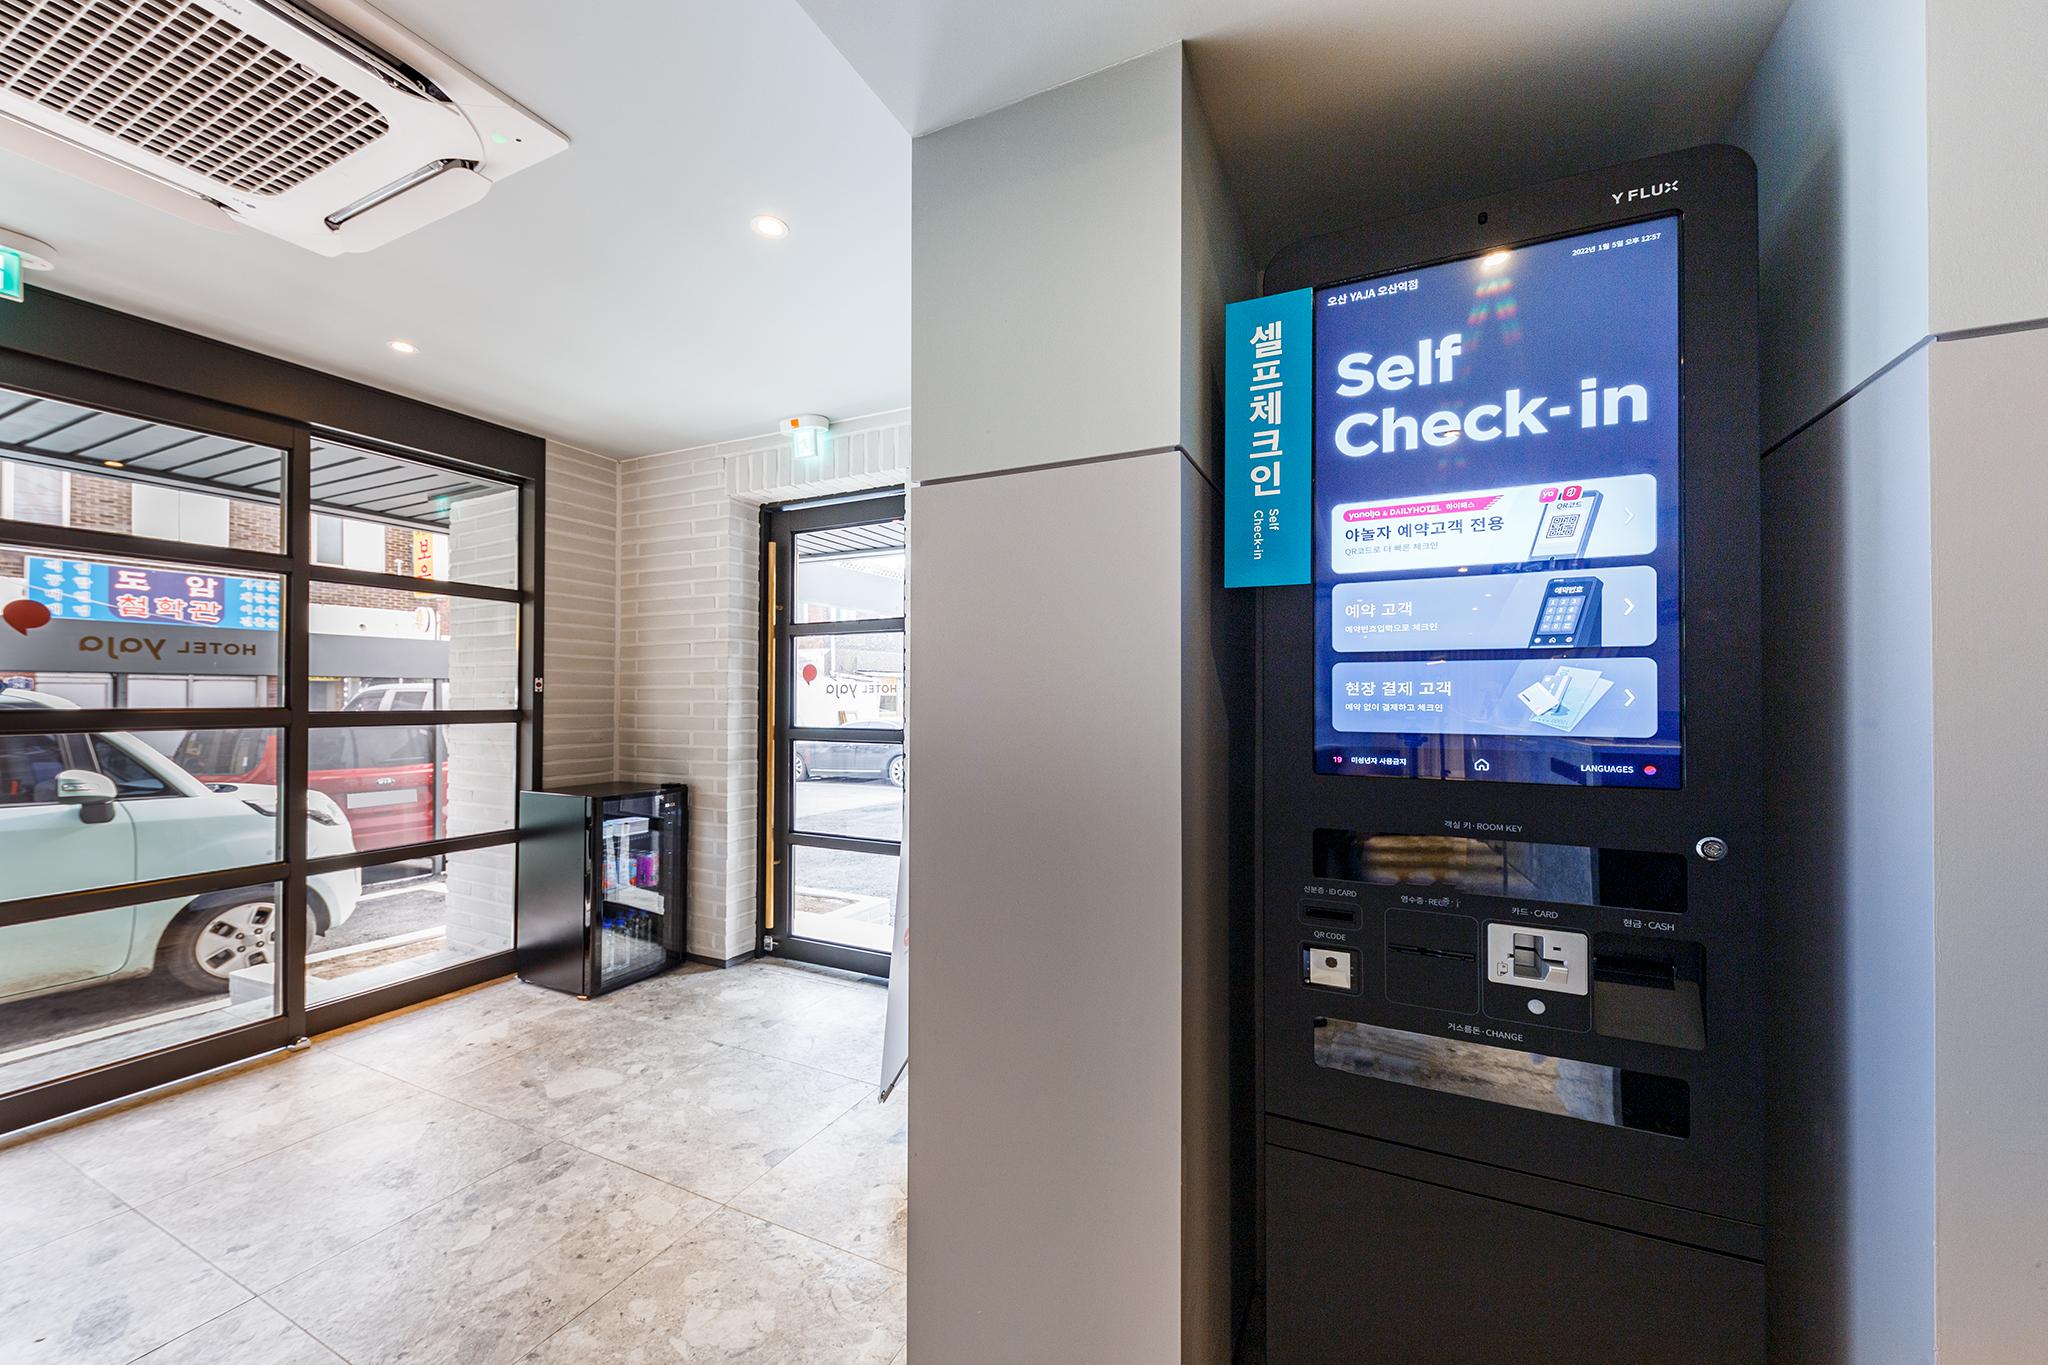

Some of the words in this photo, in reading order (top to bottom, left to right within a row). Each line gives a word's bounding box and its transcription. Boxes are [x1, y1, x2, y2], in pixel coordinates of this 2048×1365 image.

[1612, 192, 1624, 205] Y
[1628, 181, 1679, 201] FLUX
[1572, 246, 1596, 256] 2022년
[1625, 237, 1639, 246] 오후
[1641, 233, 1661, 243] 12:57
[1327, 293, 1348, 306] 오산
[1350, 289, 1376, 301] YAJA
[1377, 279, 1419, 297] 오산역점
[1336, 333, 1462, 397] Self
[1250, 320, 1283, 496] 셀프체크인
[1335, 377, 1648, 457] Check-in
[1269, 508, 1280, 531] Self
[1348, 510, 1381, 520] yanolja
[1390, 505, 1442, 516] DAILYHOTEL
[1445, 501, 1475, 511] 하이패스
[1253, 510, 1264, 560] Check-in
[1345, 526, 1392, 542] 야놀자
[1397, 519, 1464, 538] 예약고객
[1470, 516, 1505, 533] 전용
[1345, 546, 1381, 556] QR코드로
[1383, 544, 1392, 553] 더
[1394, 543, 1411, 552] 빠른
[1413, 541, 1439, 551] 체크인
[114, 569, 152, 592] 도
[185, 575, 219, 599] 암
[116, 594, 223, 625] 철학관
[1345, 603, 1376, 618] 예약
[1381, 601, 1413, 617] 고객
[1344, 623, 1411, 634] 예약번호입력으로
[1412, 623, 1438, 632] 체크인
[1345, 681, 1376, 697] 현장
[1382, 681, 1413, 697] 결제
[1419, 681, 1452, 697] 고객
[1345, 703, 1361, 712] 예약
[1363, 703, 1380, 712] 없이
[1382, 703, 1415, 712] 결제하고
[1417, 703, 1443, 713] 체크인
[1333, 756, 1343, 764] 19
[1350, 756, 1378, 765] 미성년자
[1379, 757, 1407, 766] 사용금지
[1580, 764, 1634, 774] LANGUAGES
[1444, 820, 1461, 830] 객실
[1463, 821, 1471, 830] 키
[1476, 822, 1504, 832] ROOM
[1505, 824, 1523, 833] KEY
[1328, 888, 1337, 896] ID
[1337, 889, 1357, 898] CARD
[1511, 907, 1529, 916] 카드
[1534, 909, 1559, 920] CARD
[1623, 918, 1642, 929] 현금
[1648, 921, 1675, 932] CASH
[1313, 930, 1325, 939] QR
[1325, 932, 1347, 941] CODE
[1447, 1022, 1481, 1036] 거스름돈
[1485, 1028, 1524, 1042] CHANGE
